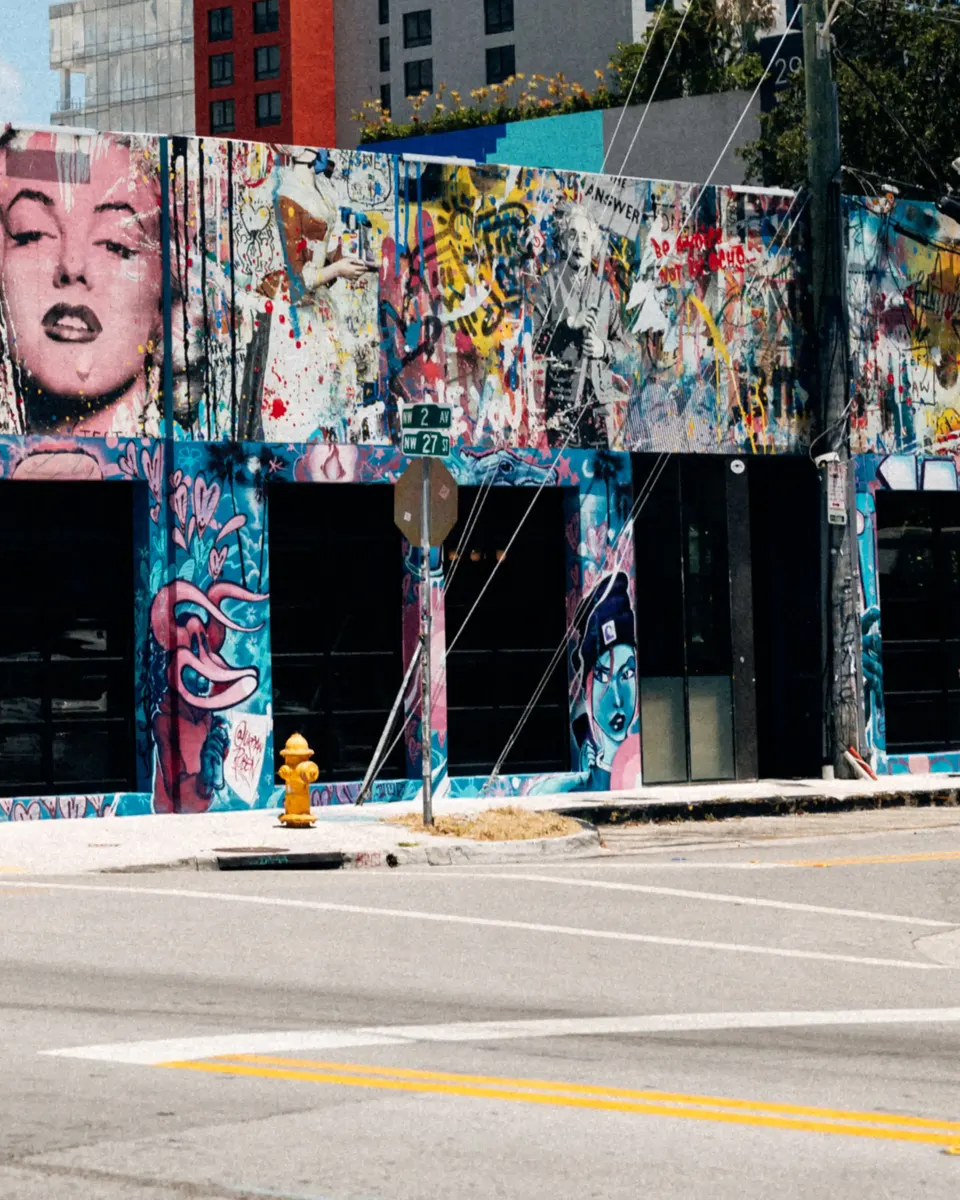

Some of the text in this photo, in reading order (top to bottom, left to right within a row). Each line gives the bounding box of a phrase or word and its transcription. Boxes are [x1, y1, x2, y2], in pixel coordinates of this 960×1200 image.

[585, 184, 641, 224] ANSWER
[403, 407, 450, 426] NW 2 AV
[404, 434, 449, 454] NW 27 ST
